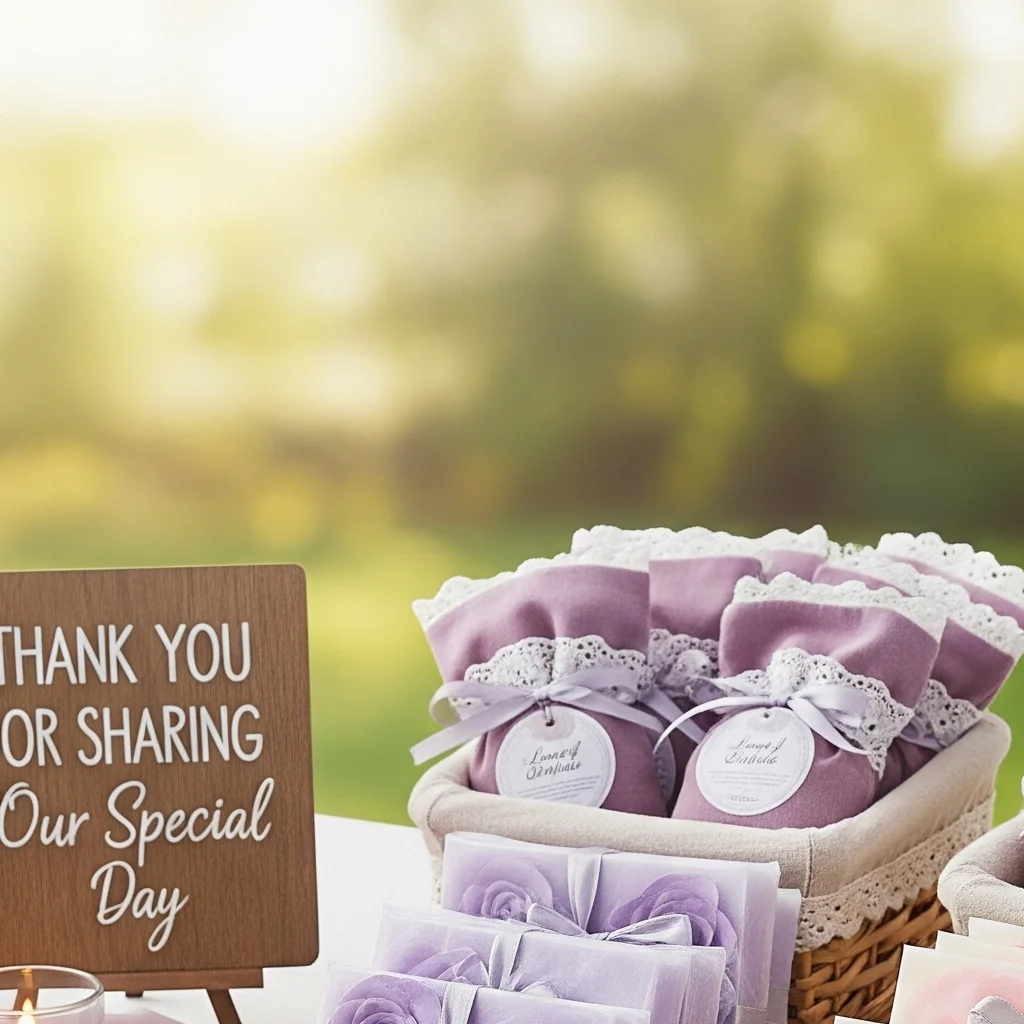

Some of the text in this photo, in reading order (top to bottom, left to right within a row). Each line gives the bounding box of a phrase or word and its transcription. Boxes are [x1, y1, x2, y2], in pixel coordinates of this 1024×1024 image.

[0, 621, 252, 686] THANK YOU
[0, 704, 264, 768] OR SHARING
[0, 777, 276, 868] Our Special
[90, 860, 190, 953] Day
